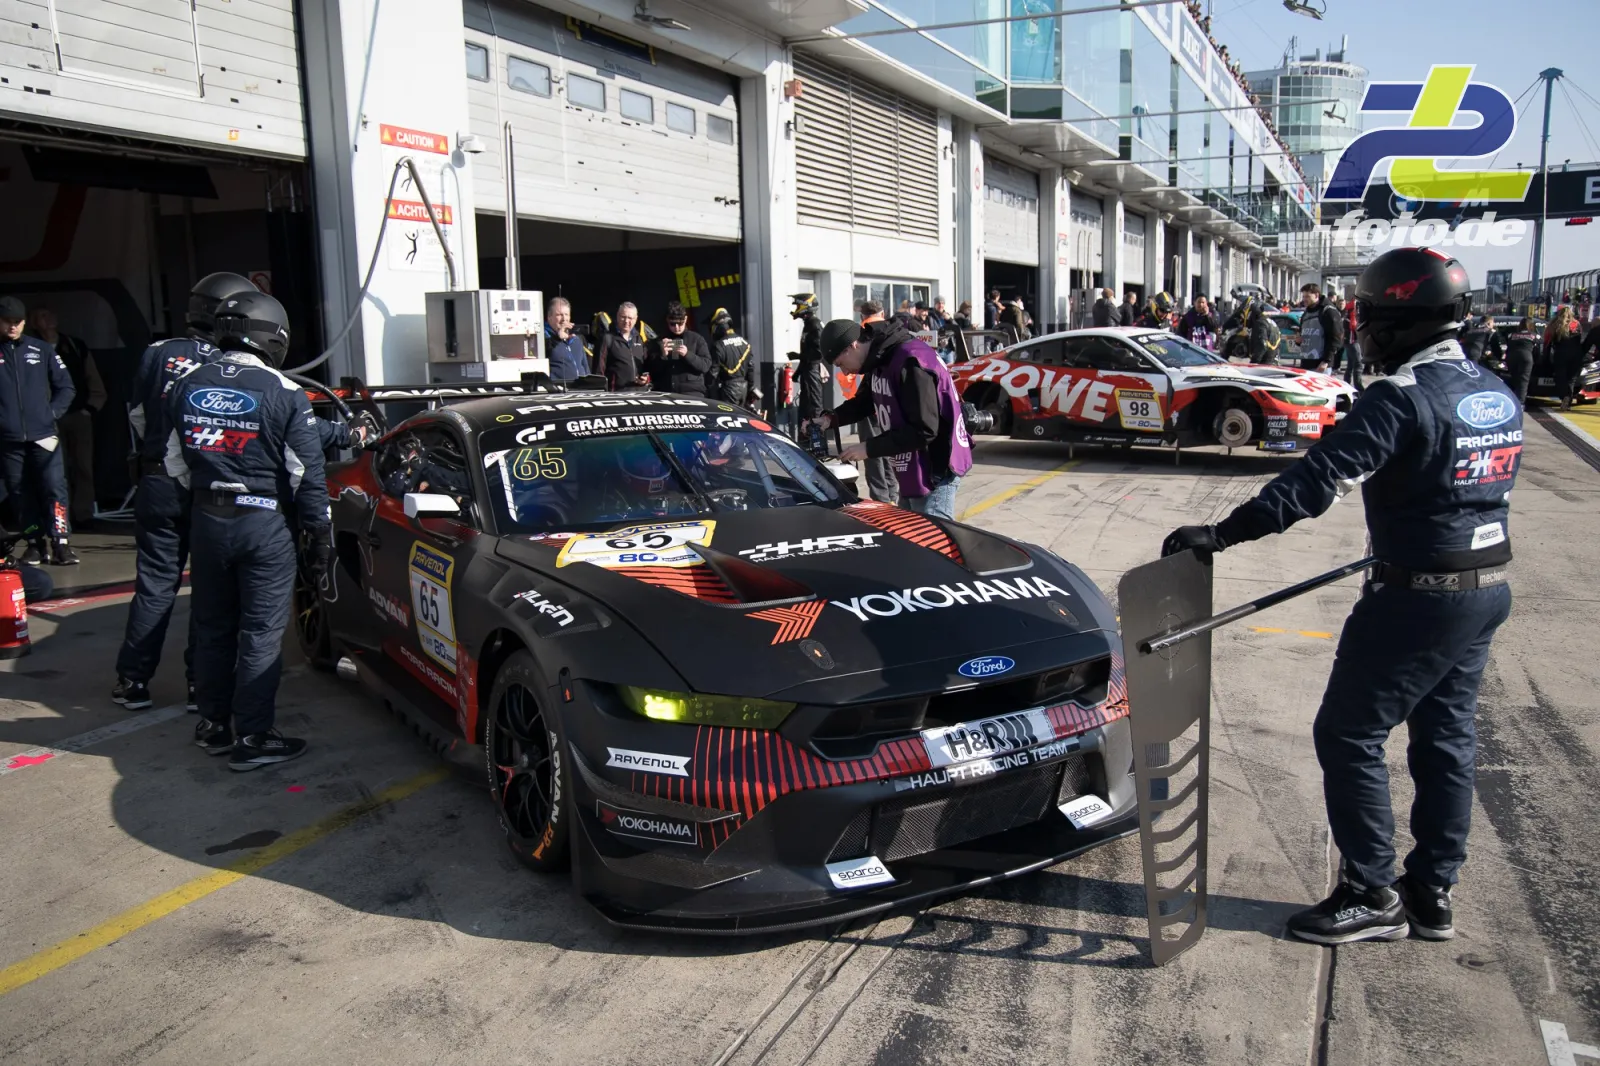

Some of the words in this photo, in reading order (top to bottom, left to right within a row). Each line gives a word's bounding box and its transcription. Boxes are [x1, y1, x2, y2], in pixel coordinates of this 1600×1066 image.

[396, 131, 434, 149] CAUTION
[397, 204, 443, 220] ACHTUG
[970, 359, 1114, 422] ROWE
[202, 391, 242, 412] Ford
[516, 400, 708, 415] RACING
[1130, 401, 1149, 417] 98
[1470, 397, 1505, 420] Ford
[183, 414, 260, 430] RACING
[566, 417, 618, 433] GRAN
[1298, 412, 1320, 420] ROWE
[571, 430, 588, 438] THE
[590, 428, 617, 436] REAL
[656, 423, 706, 431] SIMULATOR
[1456, 430, 1522, 448] RACING
[513, 448, 567, 480] 65
[1454, 478, 1478, 486] HAUPT
[236, 495, 277, 508] sparco
[605, 531, 673, 549] 65
[414, 552, 445, 576] RAVENOL
[618, 553, 658, 563] 80
[369, 587, 408, 627] ADVAN
[420, 581, 439, 627] 65
[830, 576, 1070, 622] YOKOHAMA
[400, 646, 426, 674] FORD
[427, 667, 458, 698] RACIN
[969, 660, 1006, 675] Ford
[944, 720, 1012, 761] H&R
[614, 753, 680, 770] RAVENOL
[909, 768, 967, 789] HAUPT
[971, 754, 1029, 777] RACING
[1032, 743, 1069, 762] TEAM
[549, 729, 562, 824] ADVAN
[1069, 803, 1101, 819] sparco
[617, 815, 692, 837] YOKOHAMA
[838, 866, 884, 881] sparco
